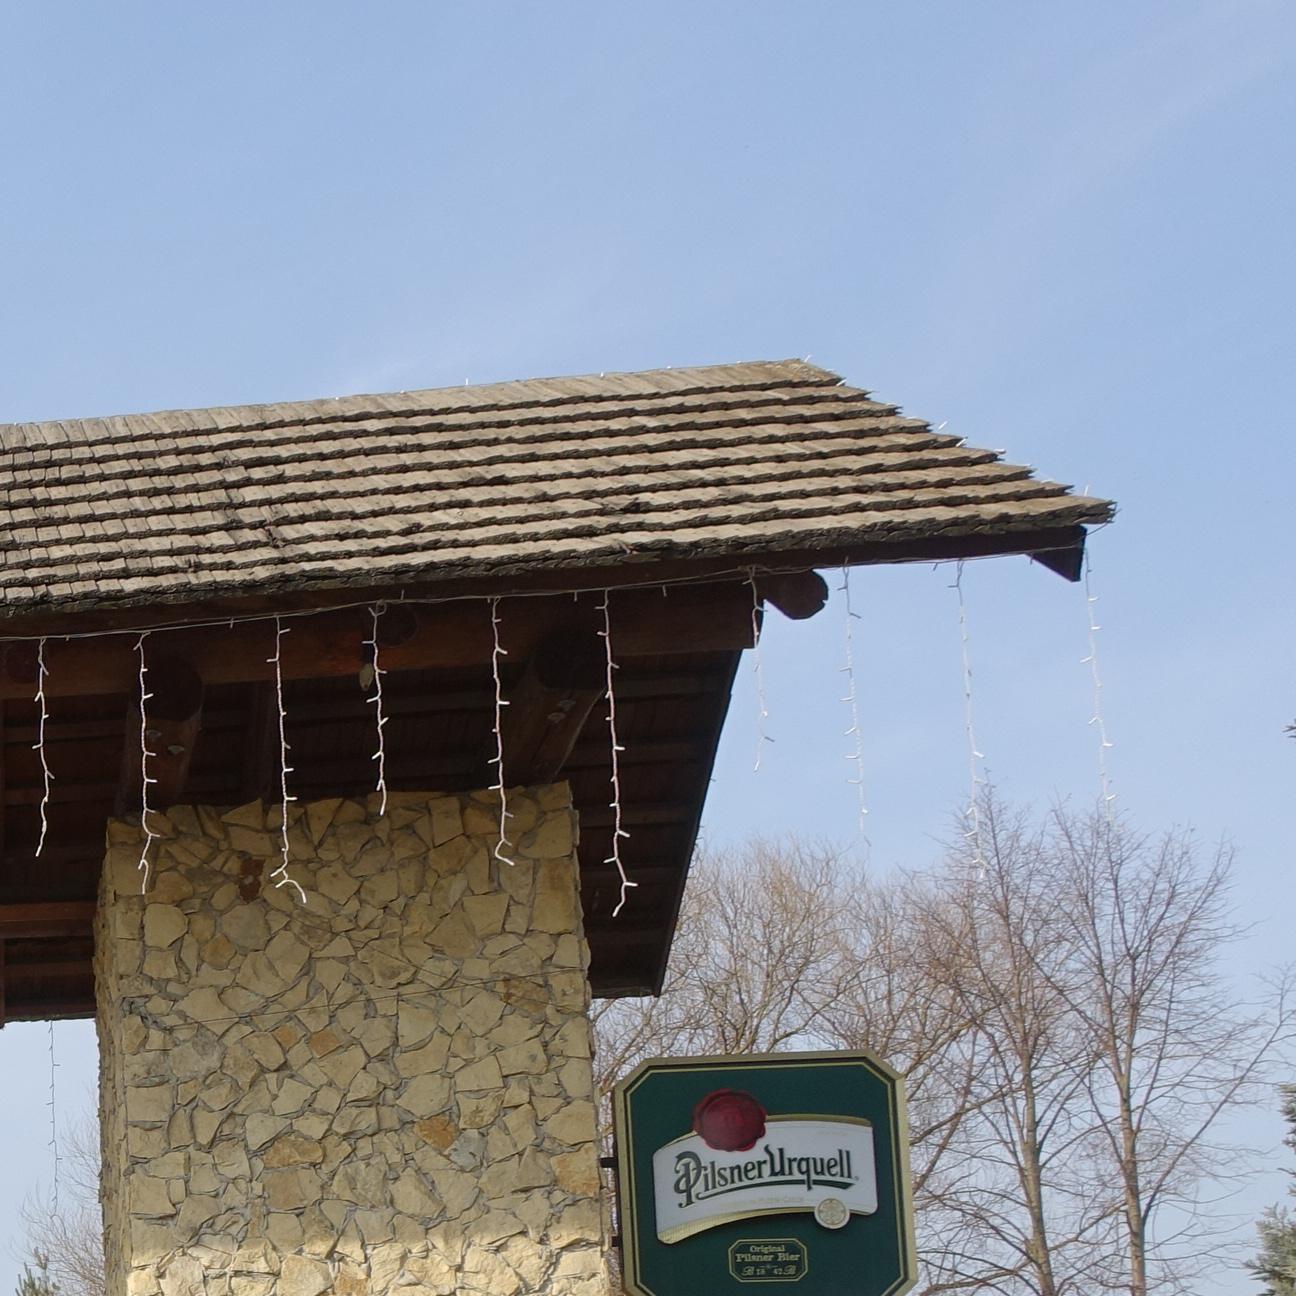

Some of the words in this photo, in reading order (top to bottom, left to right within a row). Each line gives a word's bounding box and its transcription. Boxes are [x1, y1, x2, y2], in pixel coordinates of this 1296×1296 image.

[674, 1150, 768, 1209] Pilsner
[763, 1144, 852, 1191] Urquell
[749, 1244, 786, 1254] Original
